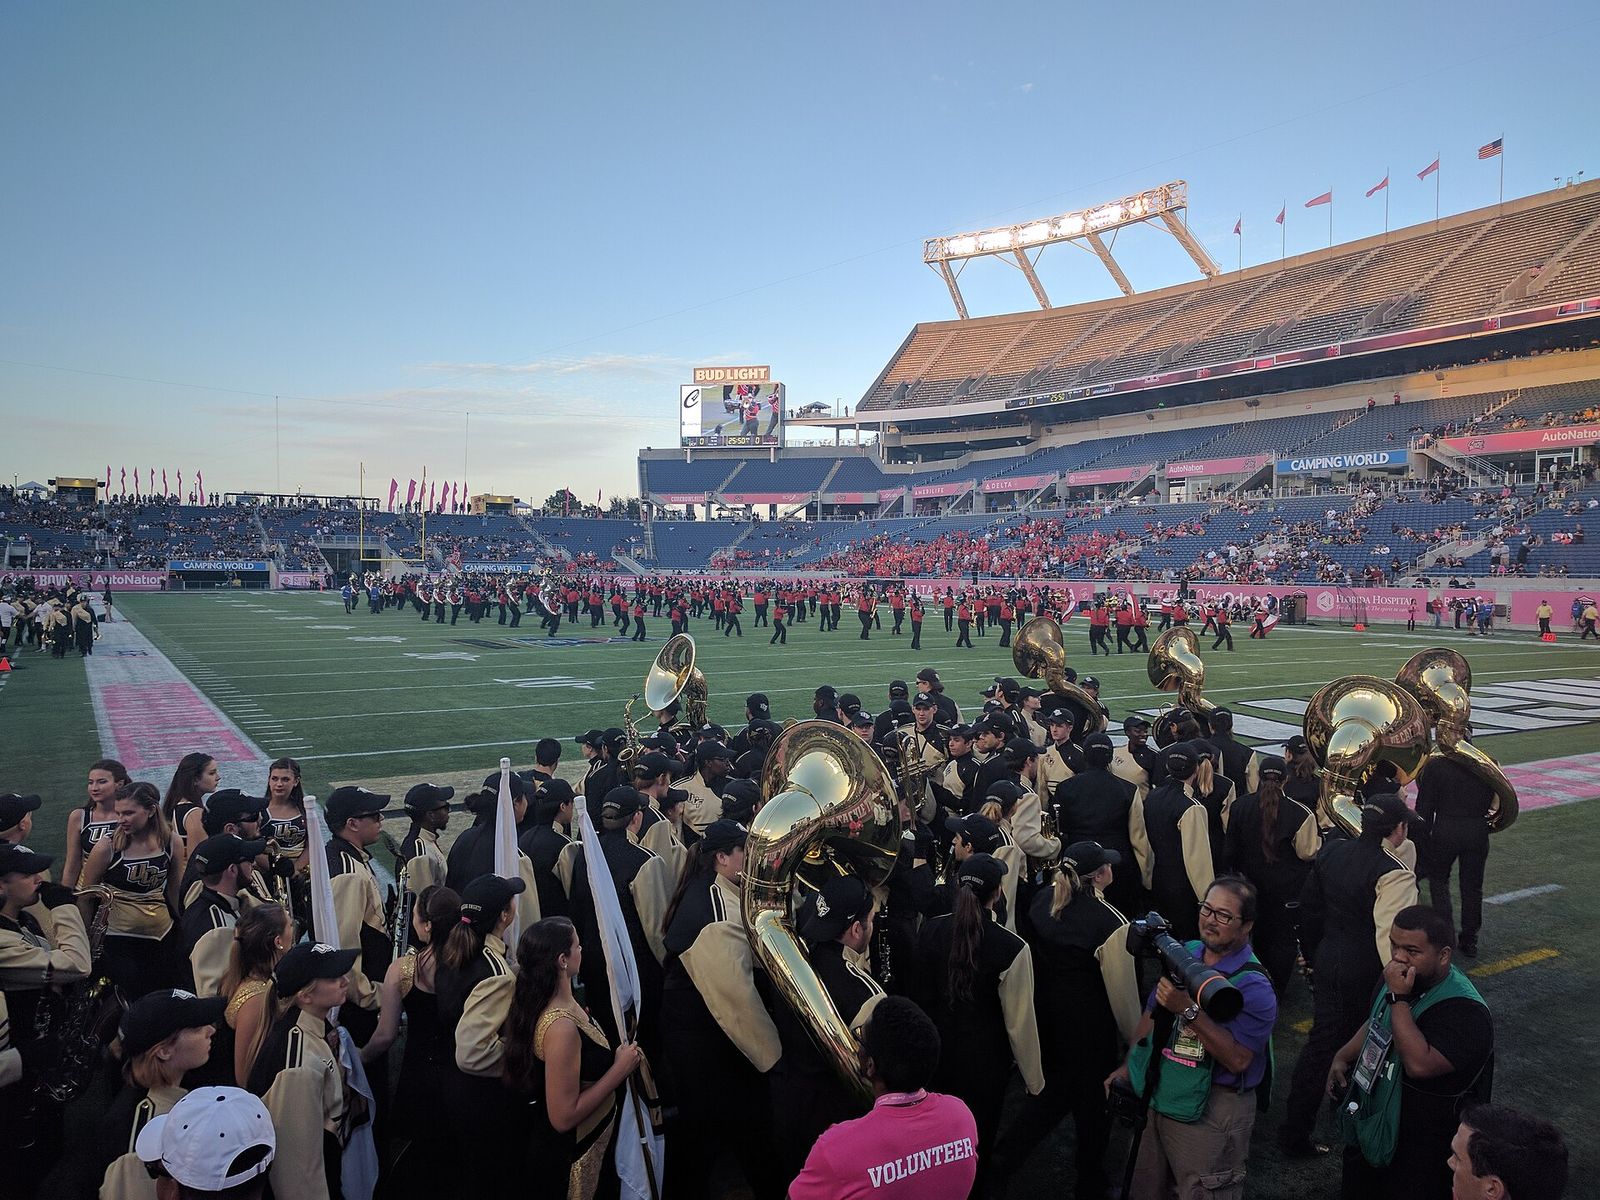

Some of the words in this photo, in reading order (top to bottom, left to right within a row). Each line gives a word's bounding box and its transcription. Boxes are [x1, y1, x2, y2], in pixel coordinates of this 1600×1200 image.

[695, 369, 725, 381] BUD
[726, 367, 767, 380] LIGHT
[1290, 456, 1342, 471] CAMPING
[1343, 452, 1390, 467] WORLD
[1169, 464, 1204, 474] AutoNation
[991, 481, 1013, 489] DELTA
[915, 487, 944, 496] AMERILIFE
[183, 561, 222, 570] CAMPING
[224, 562, 254, 570] WORLD
[1336, 595, 1371, 604] FLORIDA
[867, 1137, 973, 1188] VOLUNTEER
